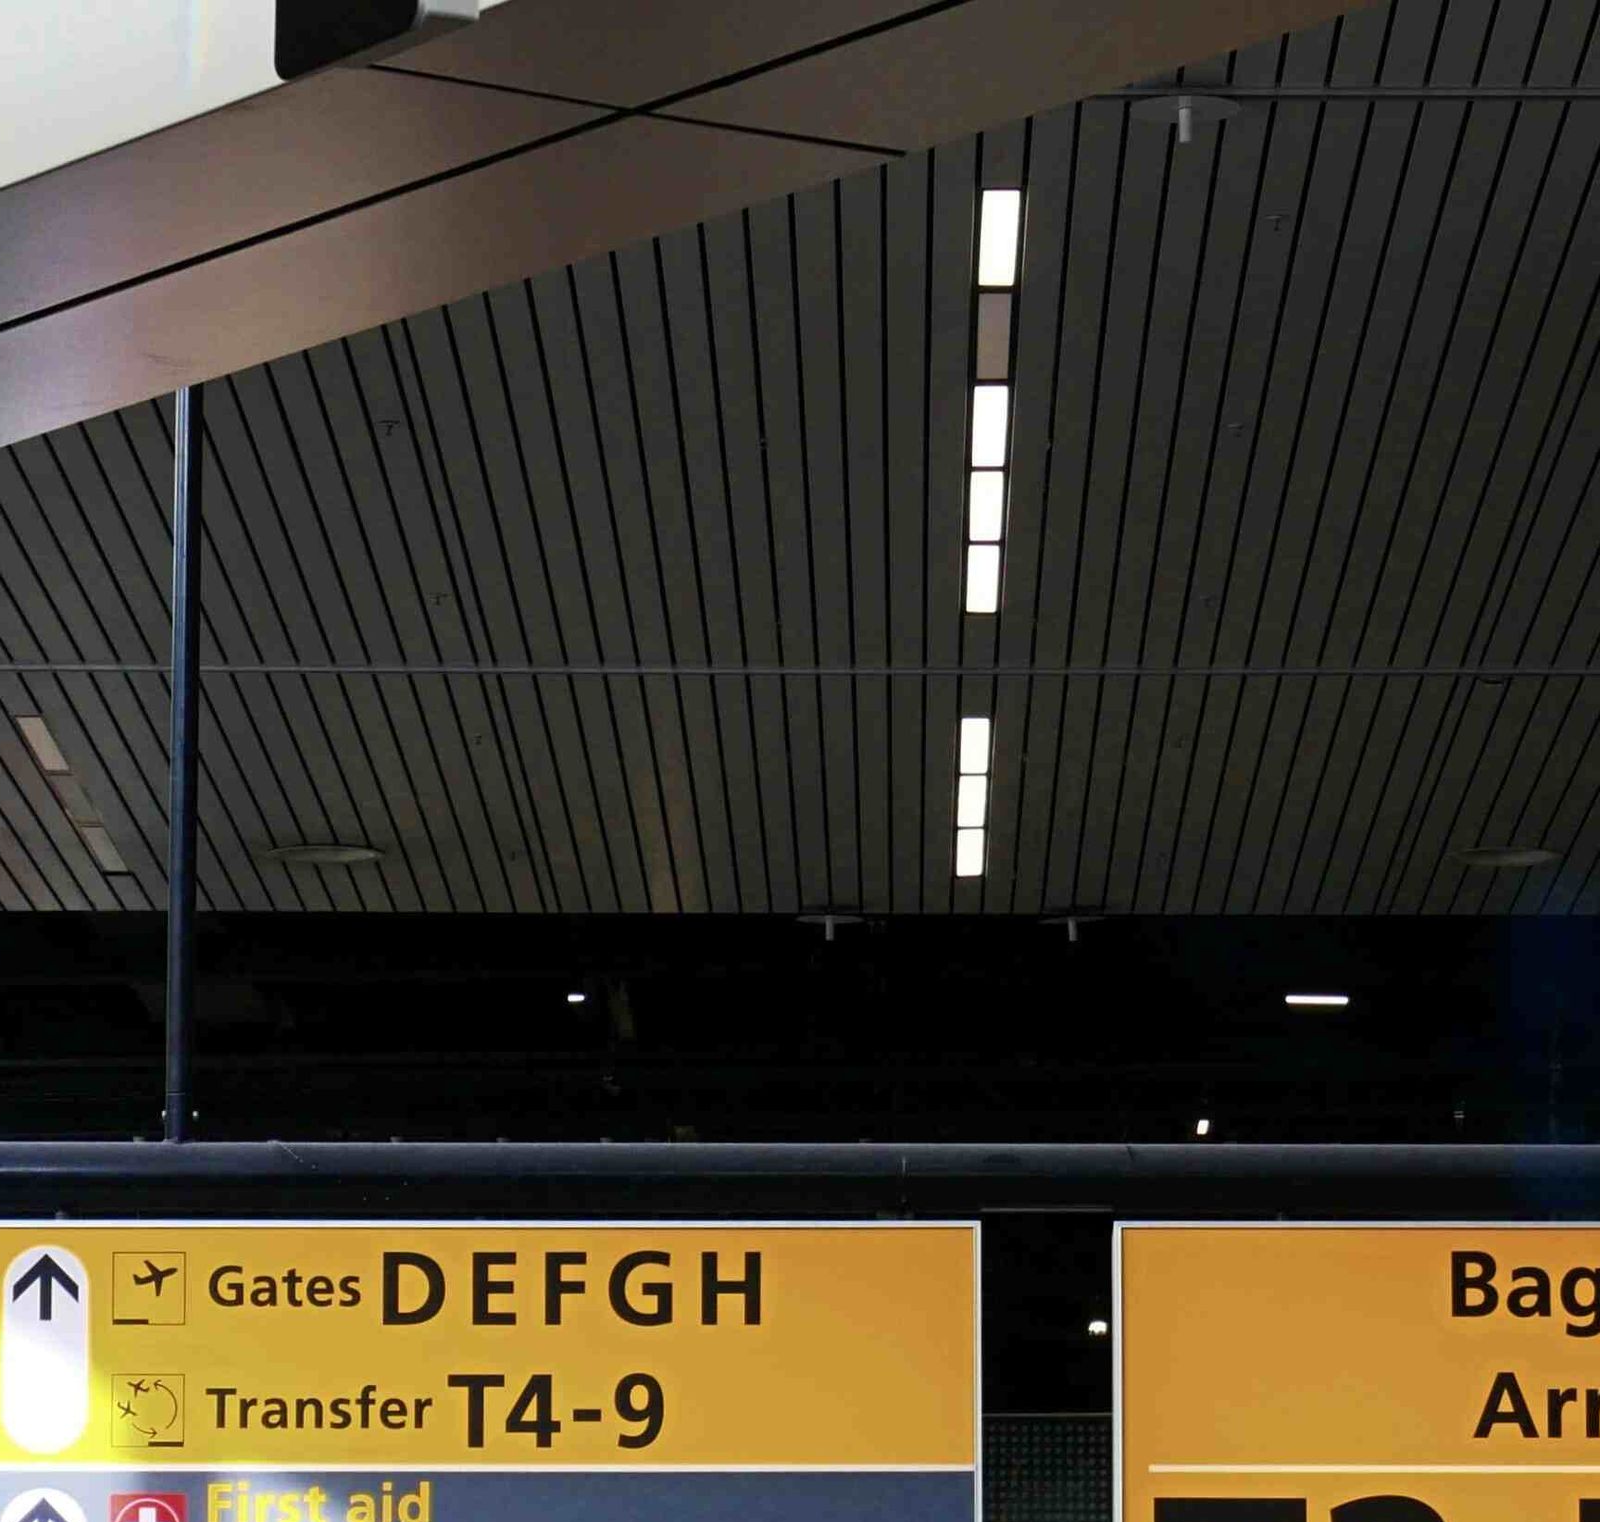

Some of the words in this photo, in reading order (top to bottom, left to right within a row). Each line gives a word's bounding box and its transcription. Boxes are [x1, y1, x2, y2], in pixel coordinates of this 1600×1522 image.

[208, 1264, 361, 1308] Gates
[205, 1384, 433, 1430] Transfer
[447, 1372, 665, 1449] T4-9
